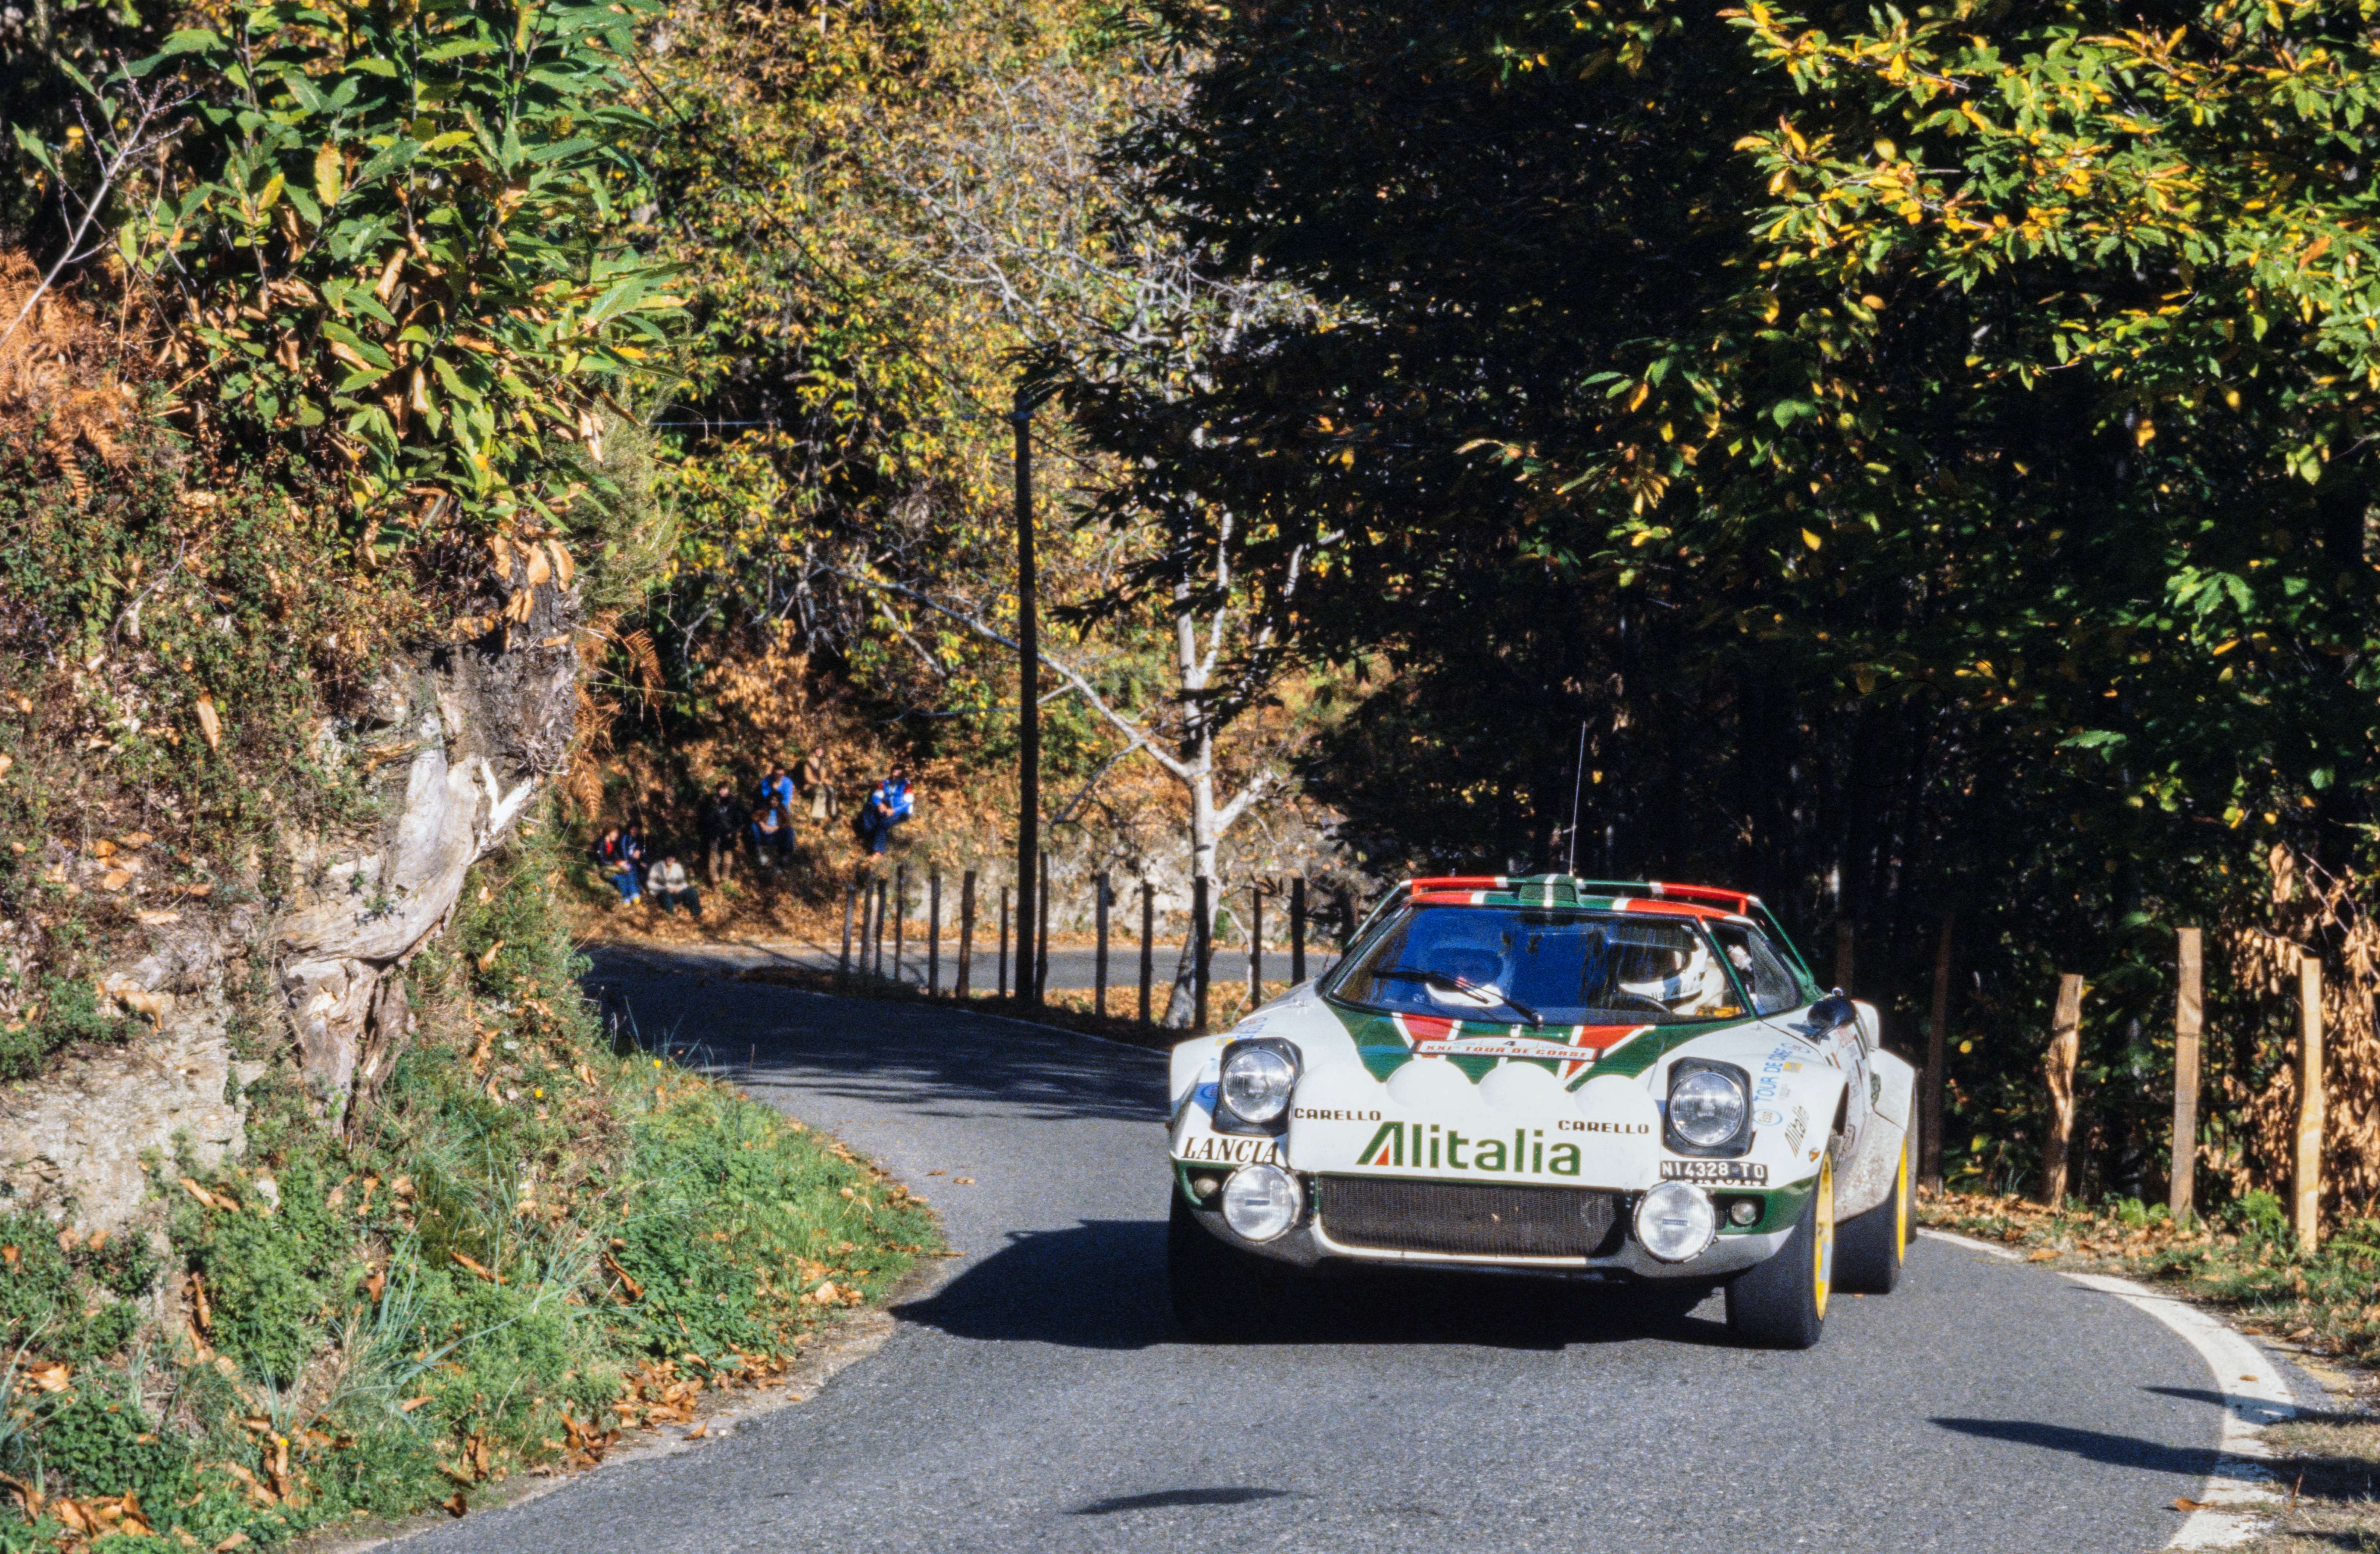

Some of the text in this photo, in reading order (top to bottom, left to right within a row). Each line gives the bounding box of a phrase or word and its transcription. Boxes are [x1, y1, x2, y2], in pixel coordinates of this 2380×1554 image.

[1763, 1062, 1783, 1073] DE
[1754, 1076, 1779, 1101] TOUR
[1294, 1107, 1382, 1121] CARELLO
[1557, 1120, 1650, 1134] CARELLO
[1784, 1105, 1810, 1158] Alitalia
[1180, 1136, 1279, 1164] LANCIA
[1355, 1121, 1581, 1176] Alitalia
